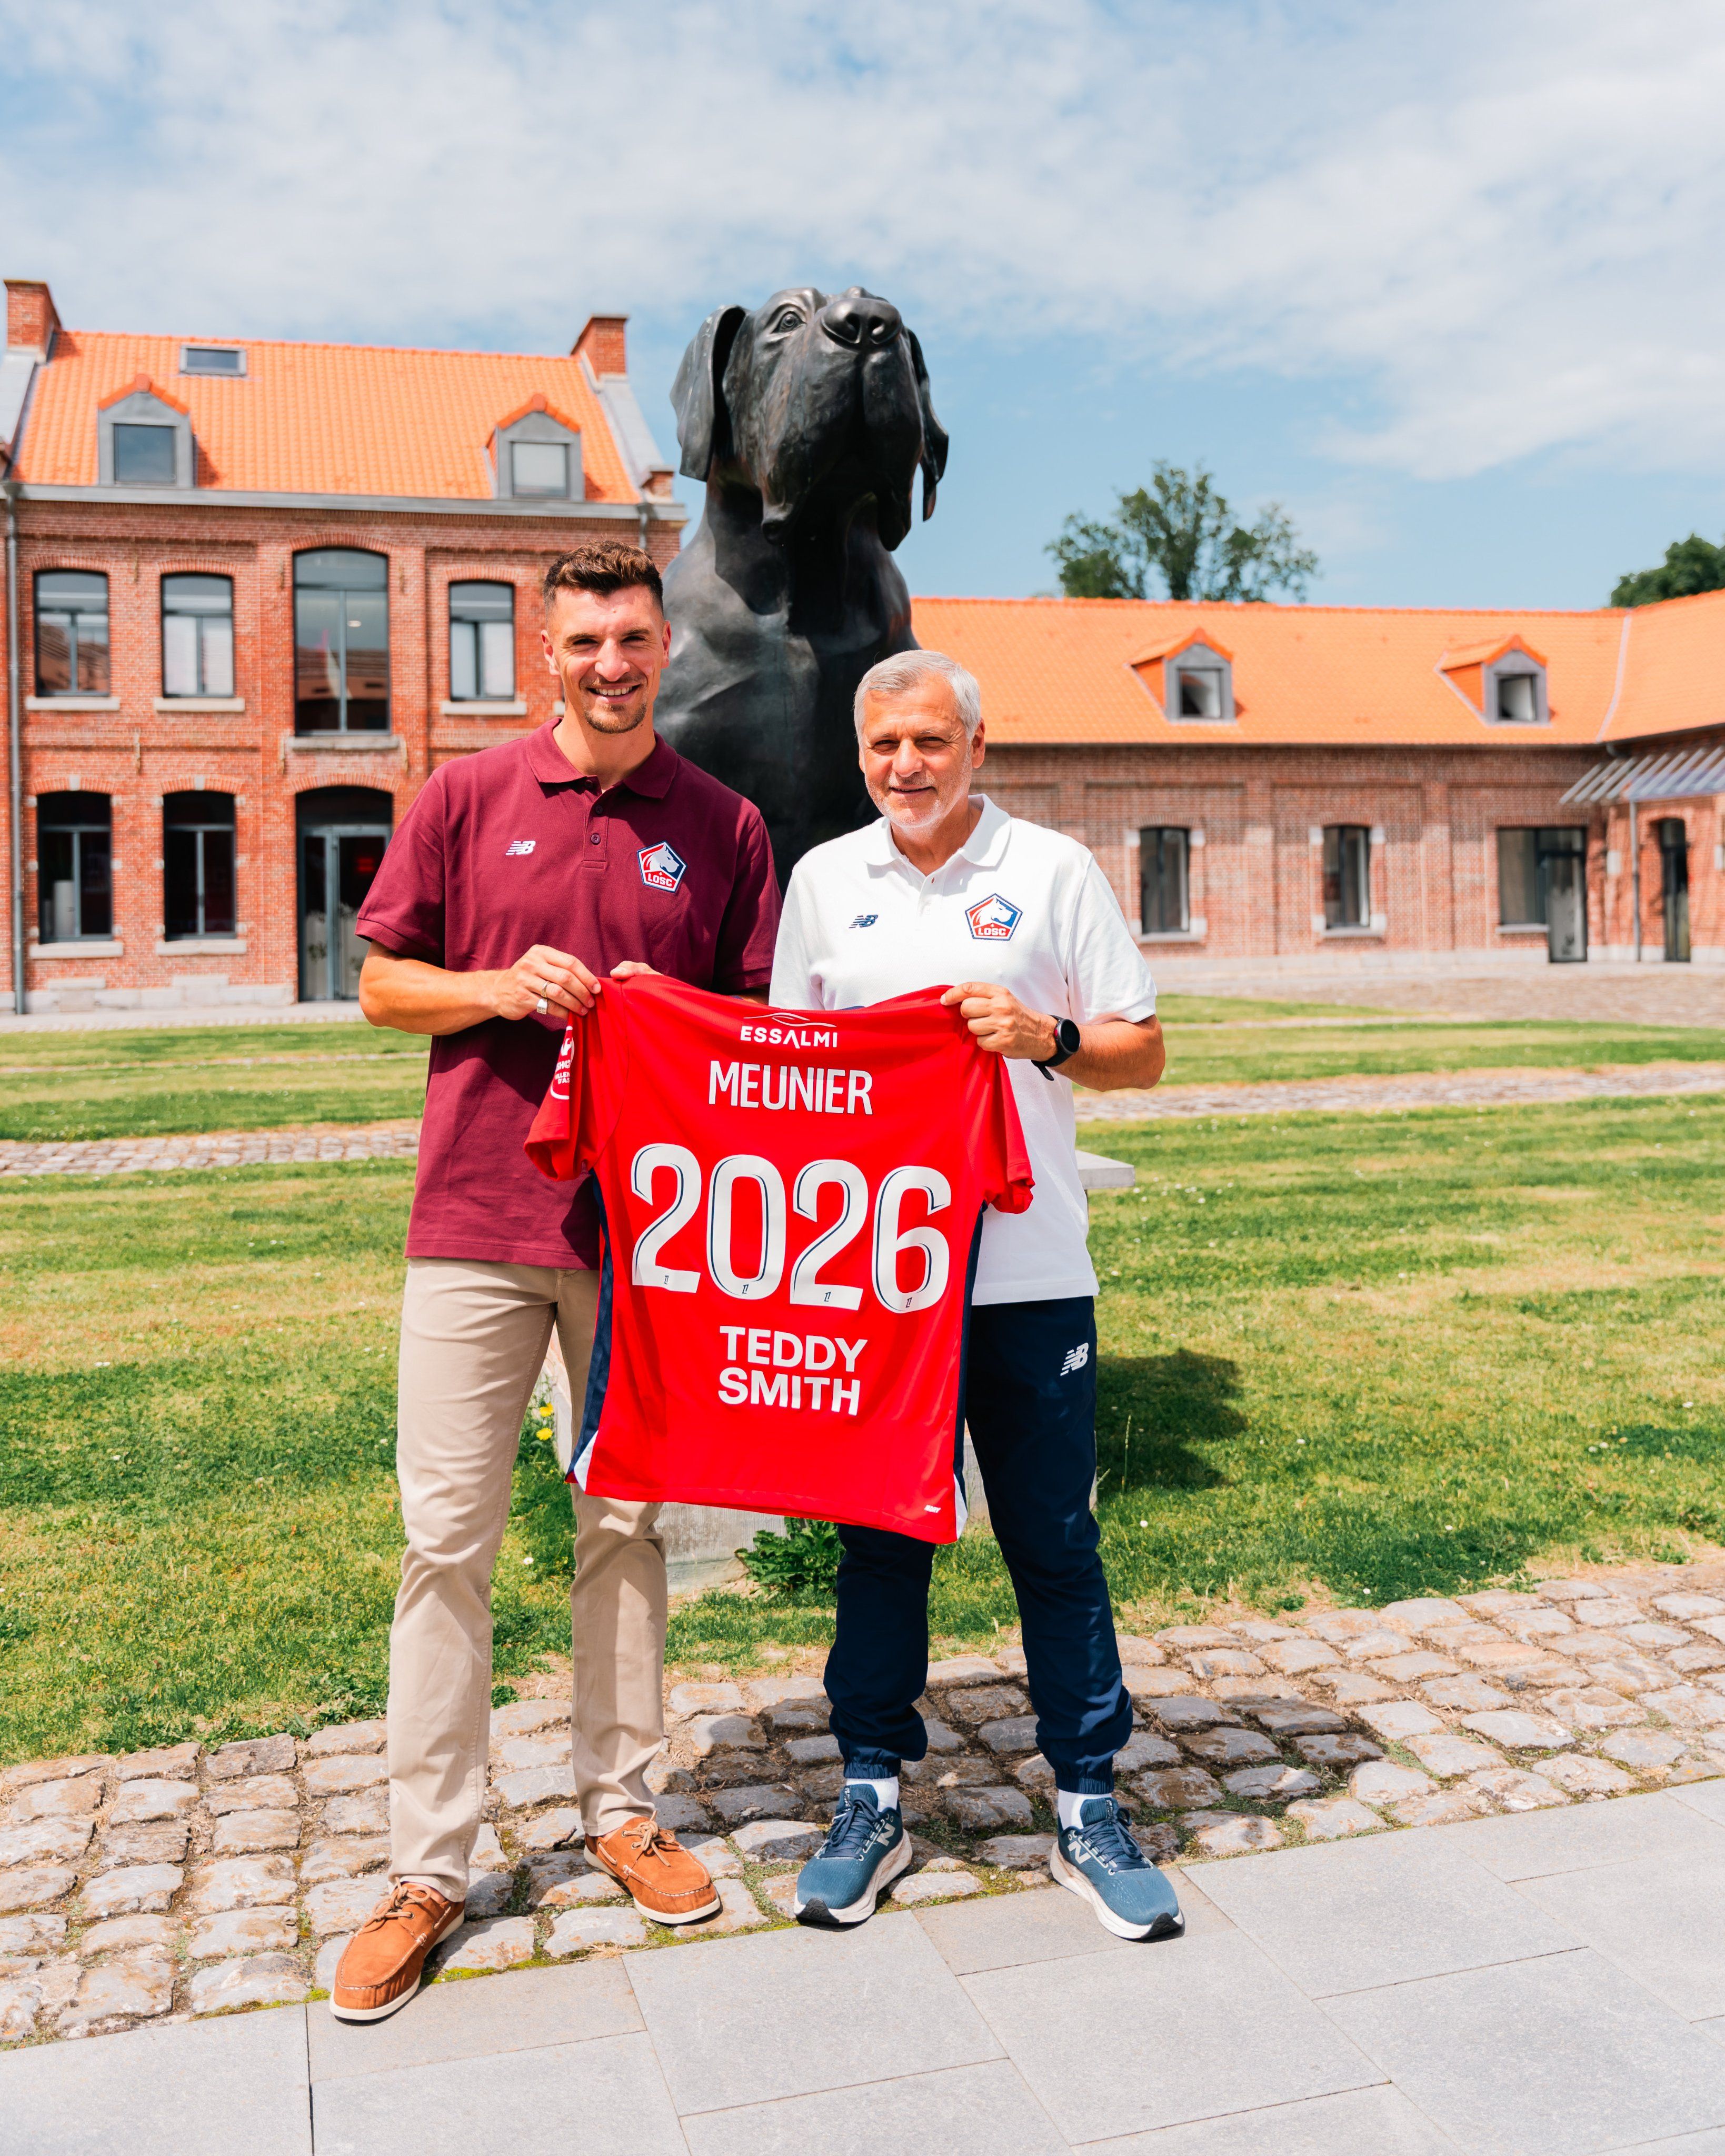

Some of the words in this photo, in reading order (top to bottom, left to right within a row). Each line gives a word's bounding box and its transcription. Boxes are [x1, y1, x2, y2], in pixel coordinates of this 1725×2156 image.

[647, 873, 673, 887] LOSC
[978, 927, 1006, 936] LOSC
[740, 1025, 837, 1049] ESSALMI
[708, 1060, 873, 1115] MEUNIER
[631, 1143, 951, 1313] 2026
[720, 1325, 868, 1372] TEDDY
[718, 1367, 861, 1416] SMITH
